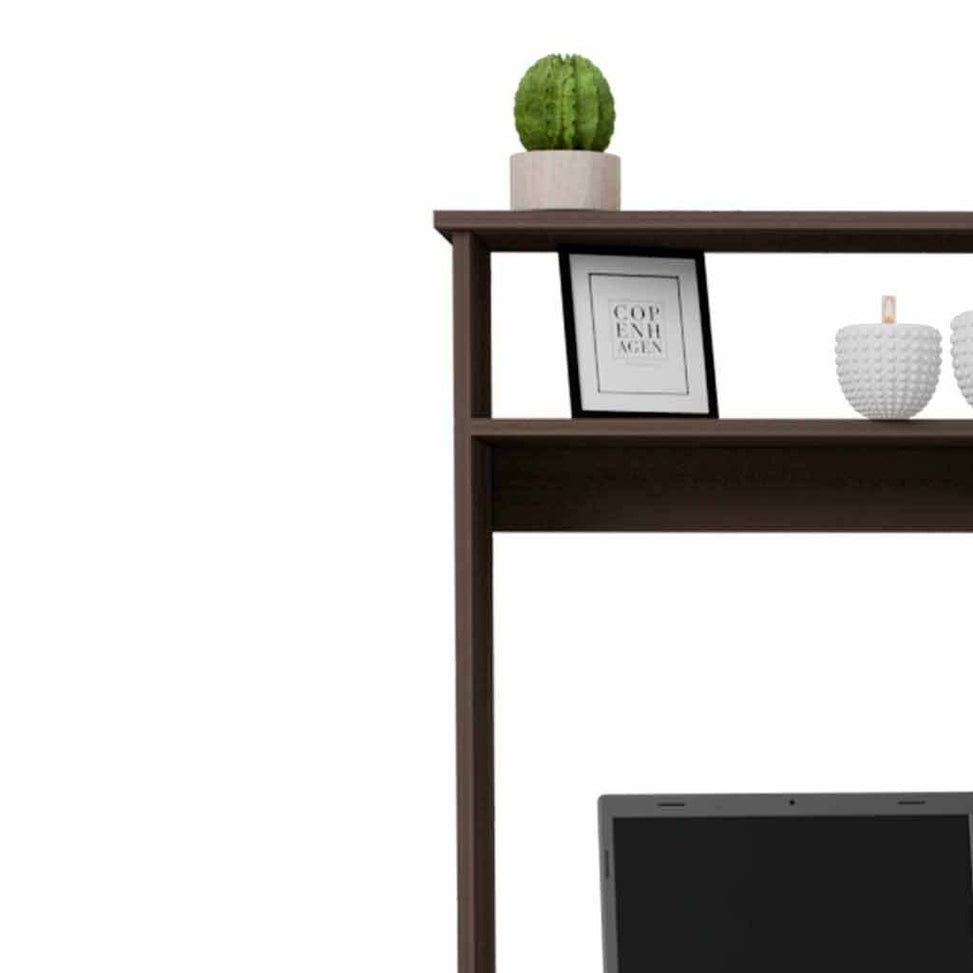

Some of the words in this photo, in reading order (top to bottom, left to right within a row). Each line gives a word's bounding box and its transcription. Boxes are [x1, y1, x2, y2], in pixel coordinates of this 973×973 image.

[613, 305, 660, 321] COP
[616, 323, 661, 339] ENH
[618, 341, 663, 354] AGEN
